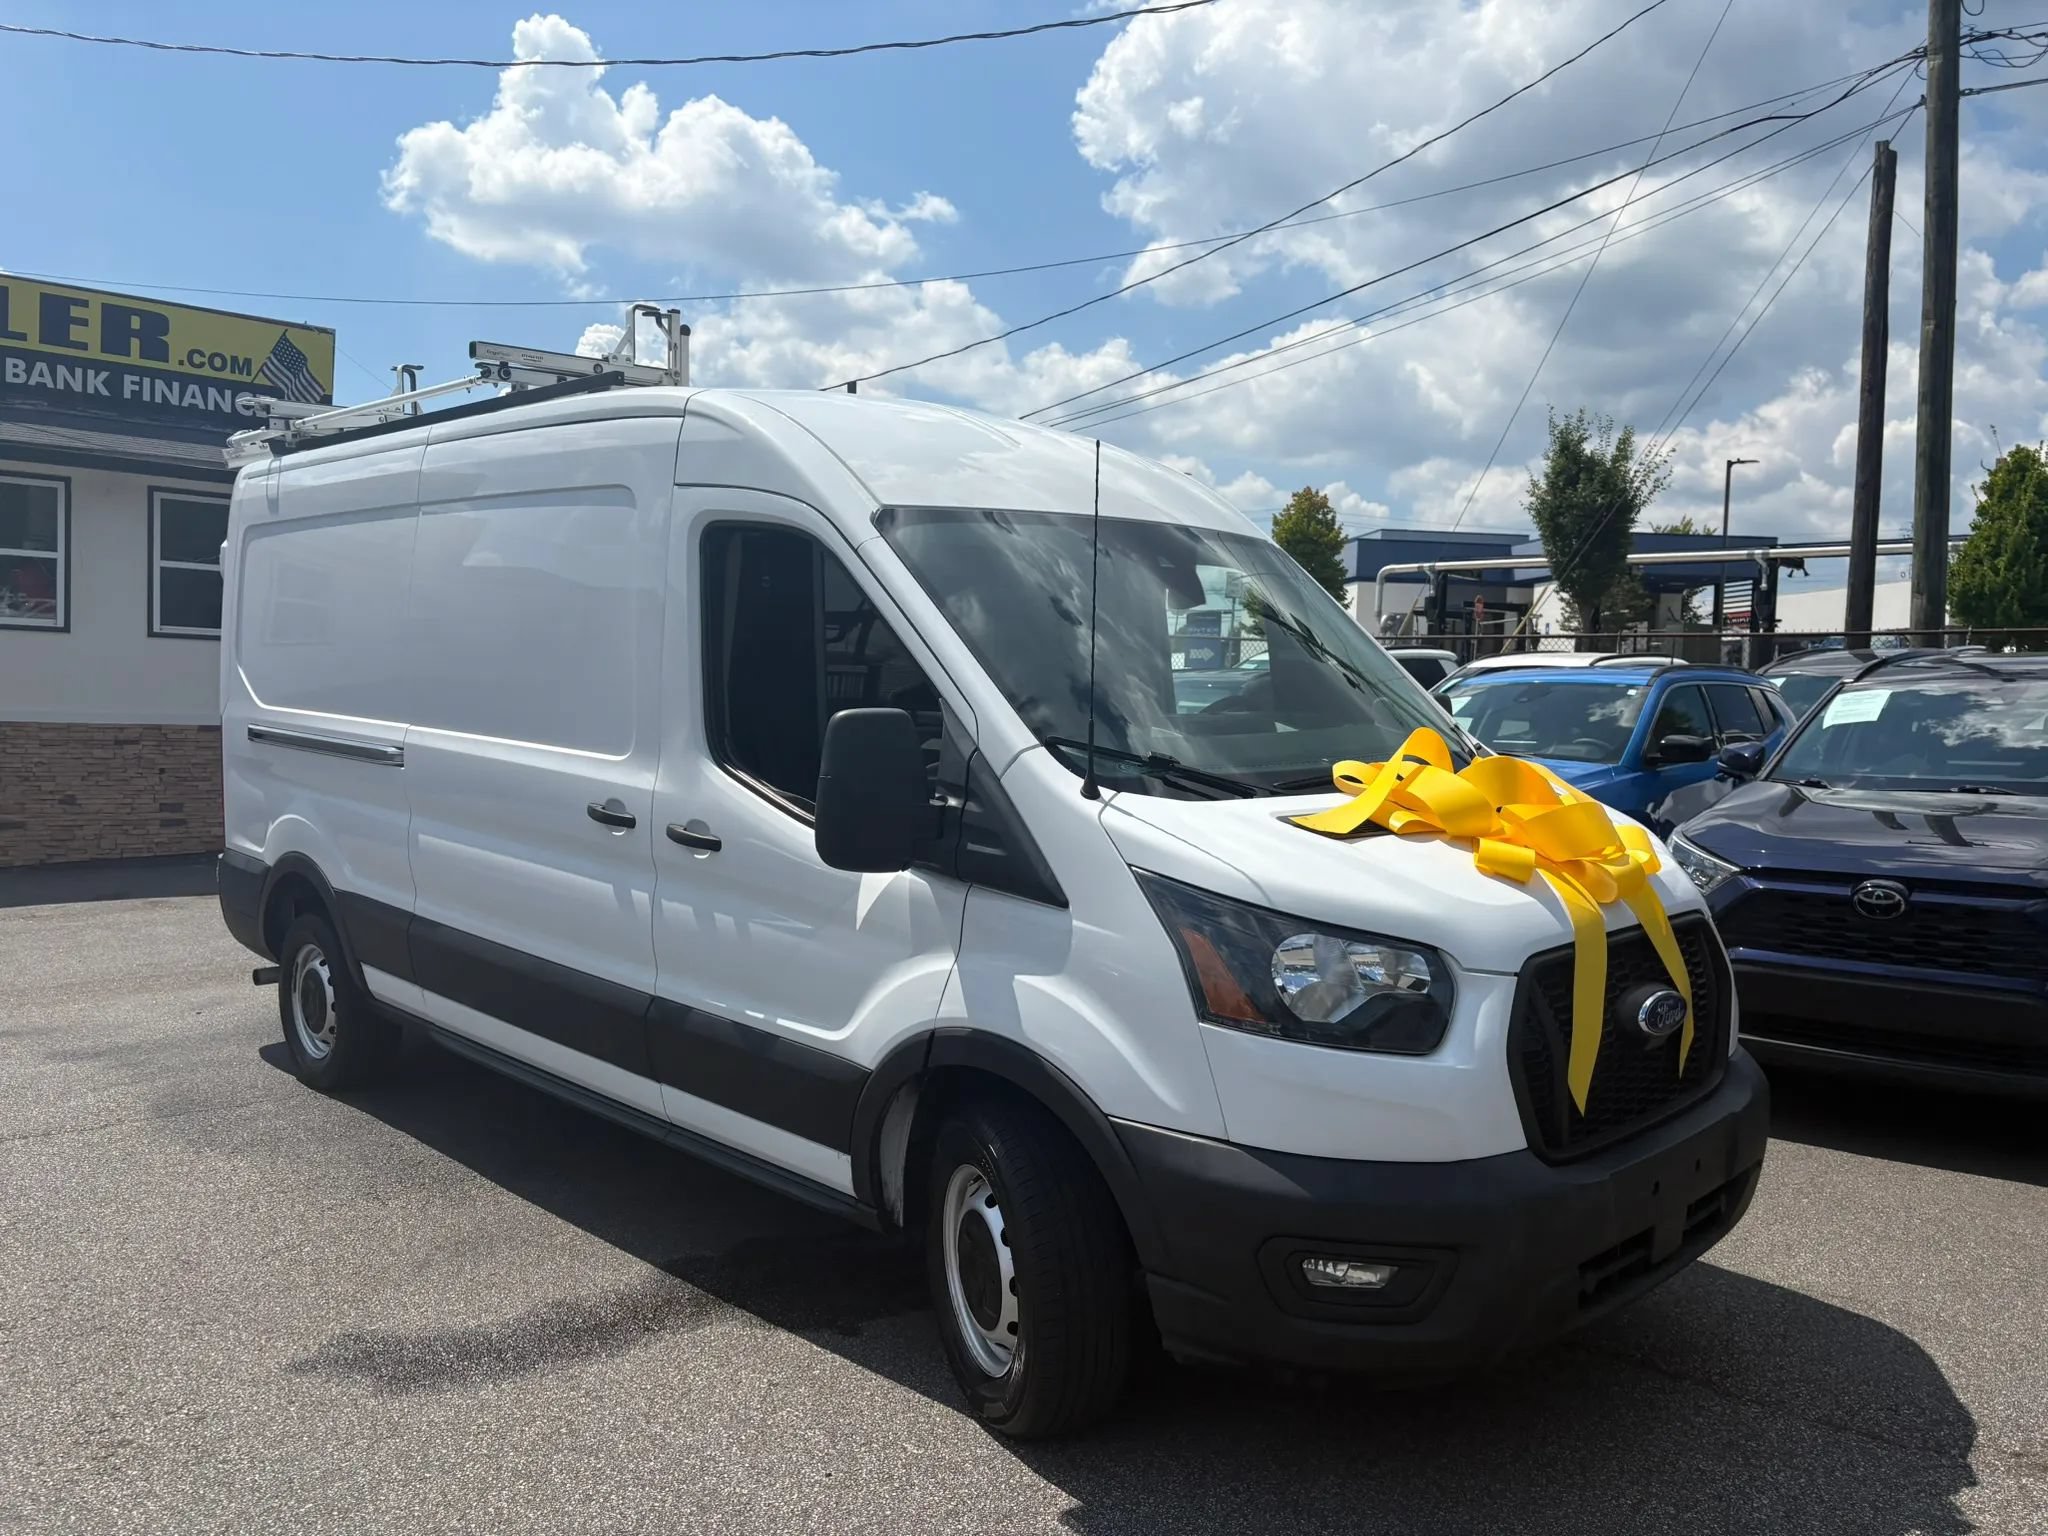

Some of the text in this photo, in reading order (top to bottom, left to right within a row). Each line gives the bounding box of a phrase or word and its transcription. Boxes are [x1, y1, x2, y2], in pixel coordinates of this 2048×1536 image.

[0, 285, 253, 377] LER .COM
[5, 356, 262, 417] BANK FINANC
[1657, 1000, 1684, 1028] Ford
